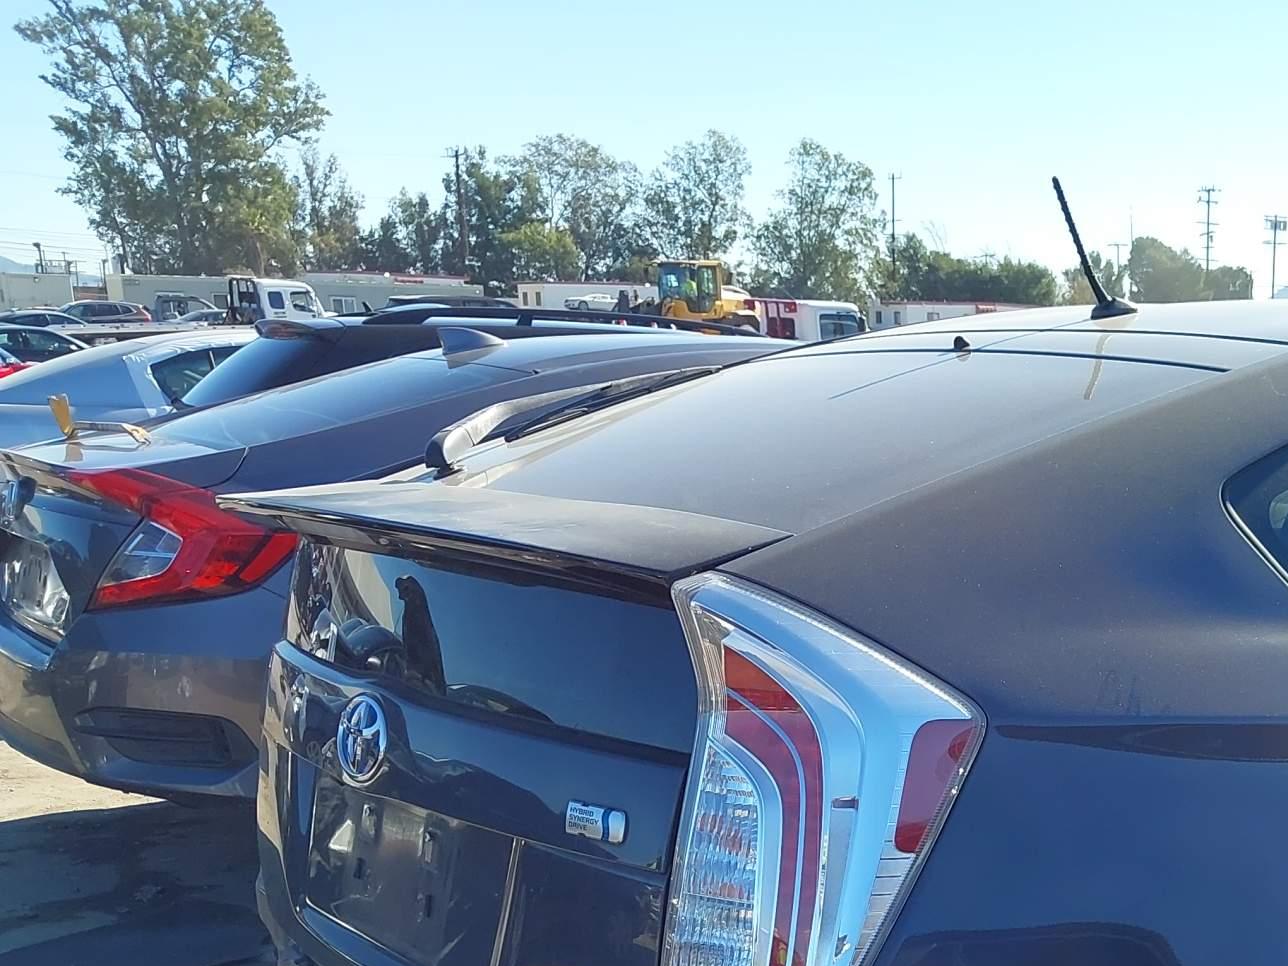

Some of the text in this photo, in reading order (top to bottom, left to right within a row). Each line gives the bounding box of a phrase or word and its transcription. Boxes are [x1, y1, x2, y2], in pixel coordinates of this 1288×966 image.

[569, 805, 594, 818] HYBRID
[568, 813, 600, 826] SYNERGY
[568, 821, 588, 832] DRIVE
